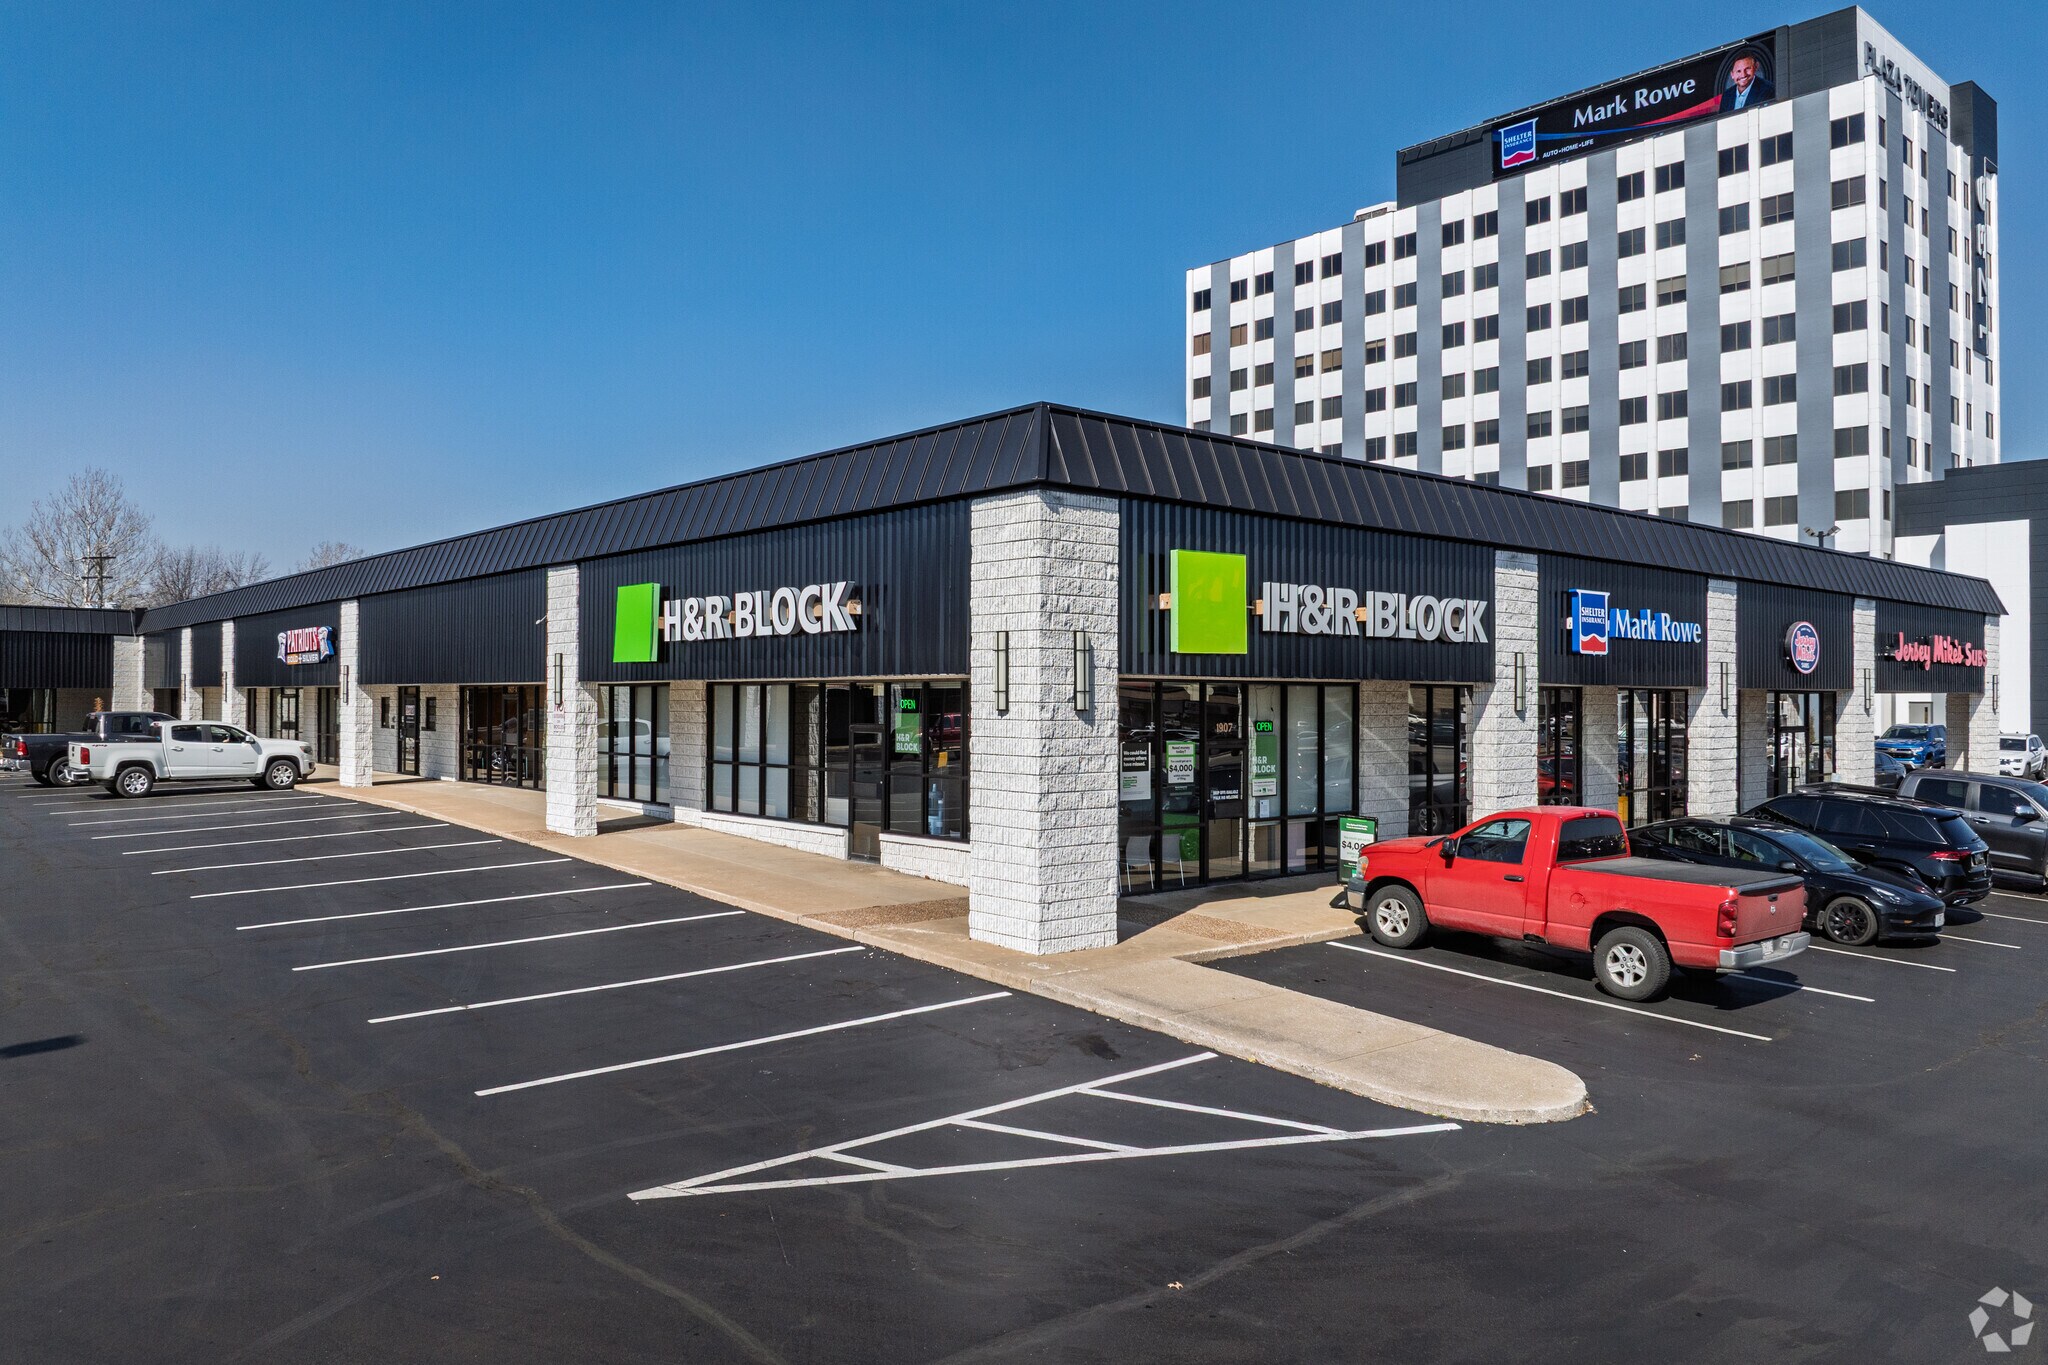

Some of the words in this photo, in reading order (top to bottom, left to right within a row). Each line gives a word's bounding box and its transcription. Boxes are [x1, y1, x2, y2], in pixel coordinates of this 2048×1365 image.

[1864, 41, 1902, 93] PLAZA
[1903, 74, 1949, 130] TOWERS
[1574, 95, 1628, 128] Mark
[1634, 79, 1696, 110] Rowe
[1504, 130, 1533, 145] SHELTER
[1504, 137, 1533, 150] INSURANCE
[664, 595, 730, 642] H&R
[735, 581, 853, 639] BLOCK
[1263, 581, 1360, 637] H&R
[1366, 590, 1489, 643] BLOCK
[1581, 606, 1605, 618] SHELTER
[1581, 616, 1606, 625] INSURANCE
[1614, 608, 1656, 641] Mark
[1660, 612, 1702, 643] Rowe
[287, 626, 319, 654] PATRIOTS
[1795, 631, 1816, 651] Jersey
[1895, 631, 1931, 671] Jersey
[1933, 634, 1964, 665] Mike's
[900, 699, 916, 710] OPEN
[1216, 722, 1233, 733] 1907
[1256, 722, 1272, 732] OPEN
[896, 733, 910, 742] H&R
[896, 742, 918, 752] BLOCK
[1169, 764, 1193, 773] $4,000
